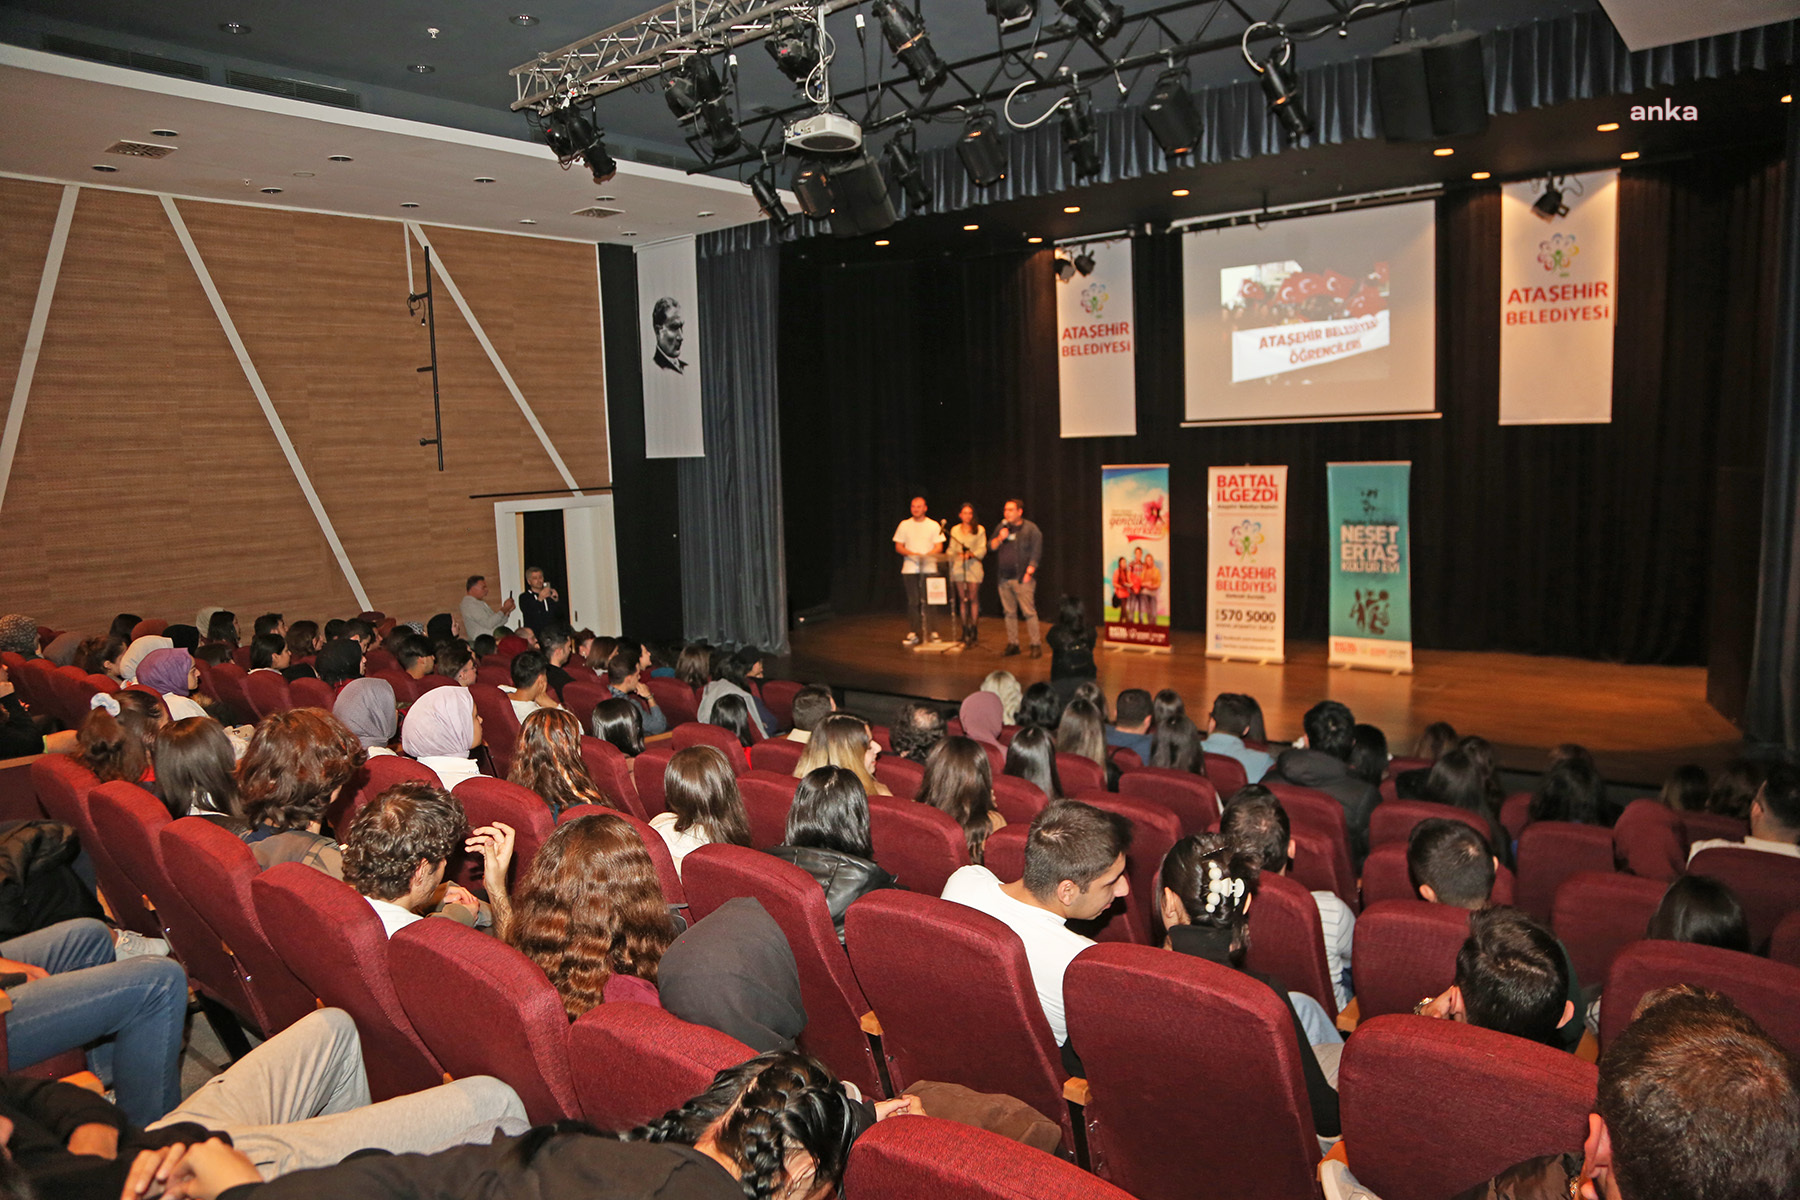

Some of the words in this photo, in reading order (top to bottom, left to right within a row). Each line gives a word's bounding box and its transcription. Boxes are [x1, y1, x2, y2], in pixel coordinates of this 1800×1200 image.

[1507, 281, 1608, 305] ATAŞEHİR
[1506, 304, 1609, 326] BELEDİYESİ
[1062, 321, 1129, 340] ATAŞEHİR
[1259, 328, 1322, 349] ATAŞEHİR
[1062, 340, 1131, 357] BELEDİYESİ
[1217, 474, 1279, 488] BATTAL
[1217, 487, 1279, 502] İLGEZDİ
[1216, 565, 1277, 580] ATAŞEHİR
[1215, 580, 1277, 593] BELEDİYESİ
[1221, 609, 1243, 621] 570
[1246, 610, 1276, 623] 5000
